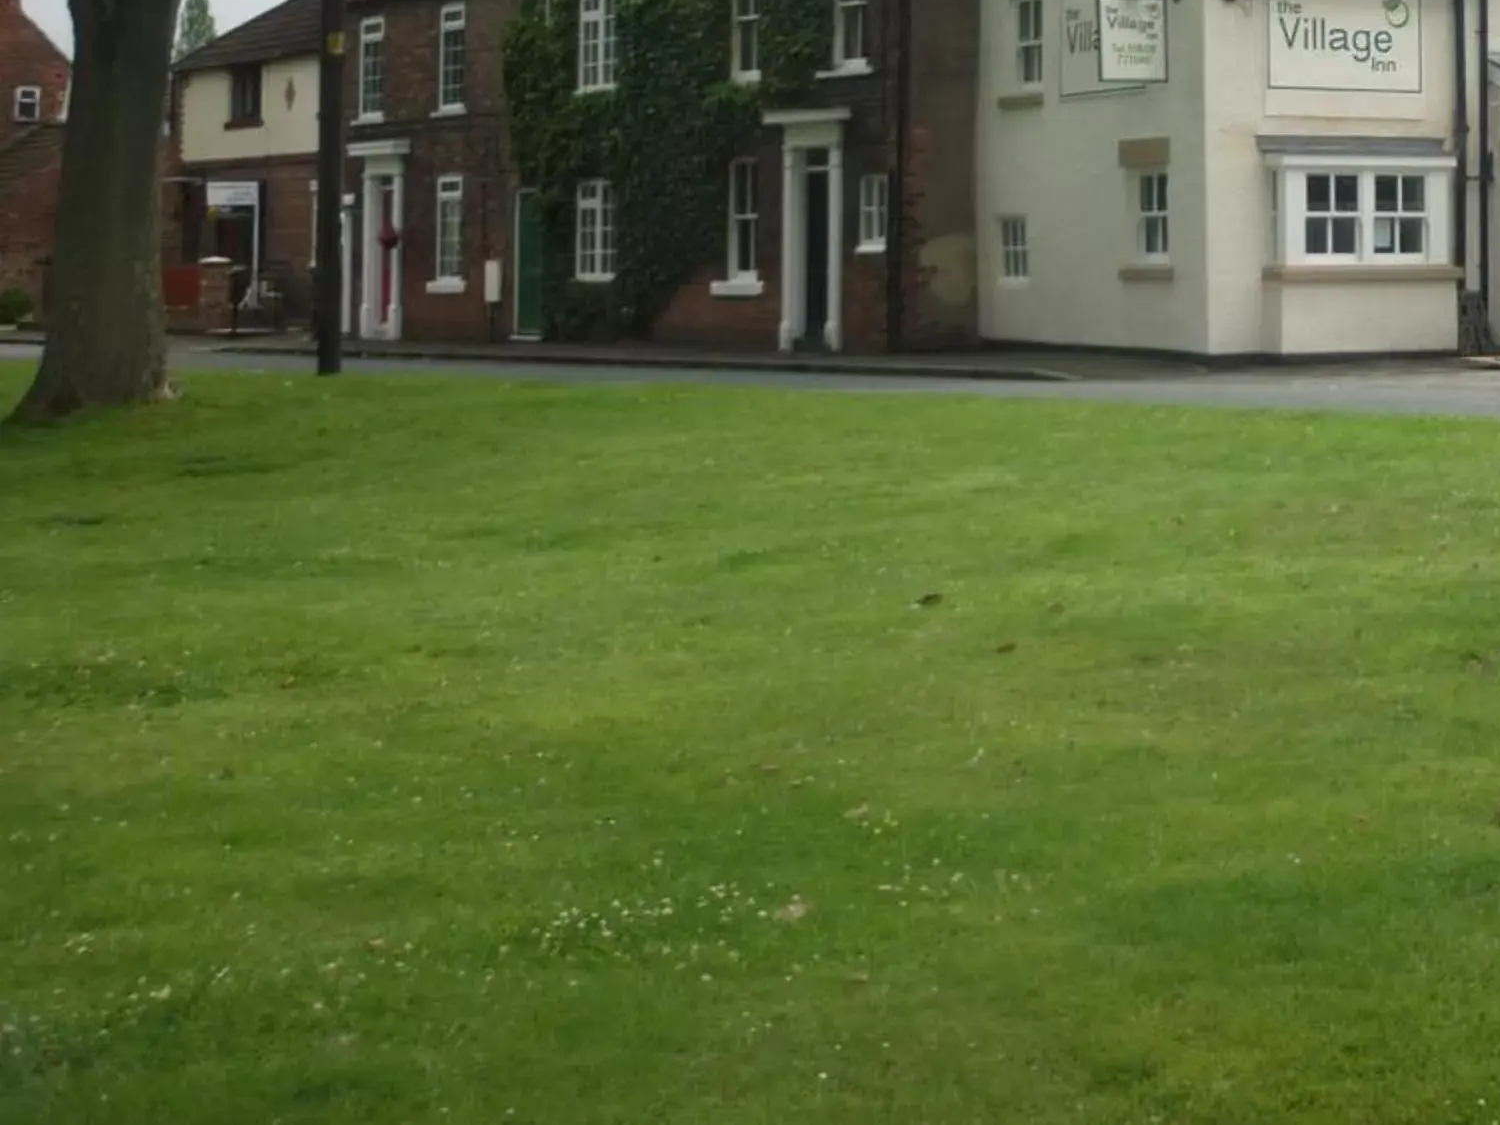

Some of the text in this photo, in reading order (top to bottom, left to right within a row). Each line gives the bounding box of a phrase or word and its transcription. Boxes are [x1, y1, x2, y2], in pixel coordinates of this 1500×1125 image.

[1277, 0, 1303, 14] the
[1106, 15, 1156, 33] Village
[1279, 17, 1393, 62] Village
[1371, 56, 1397, 72] Inn
